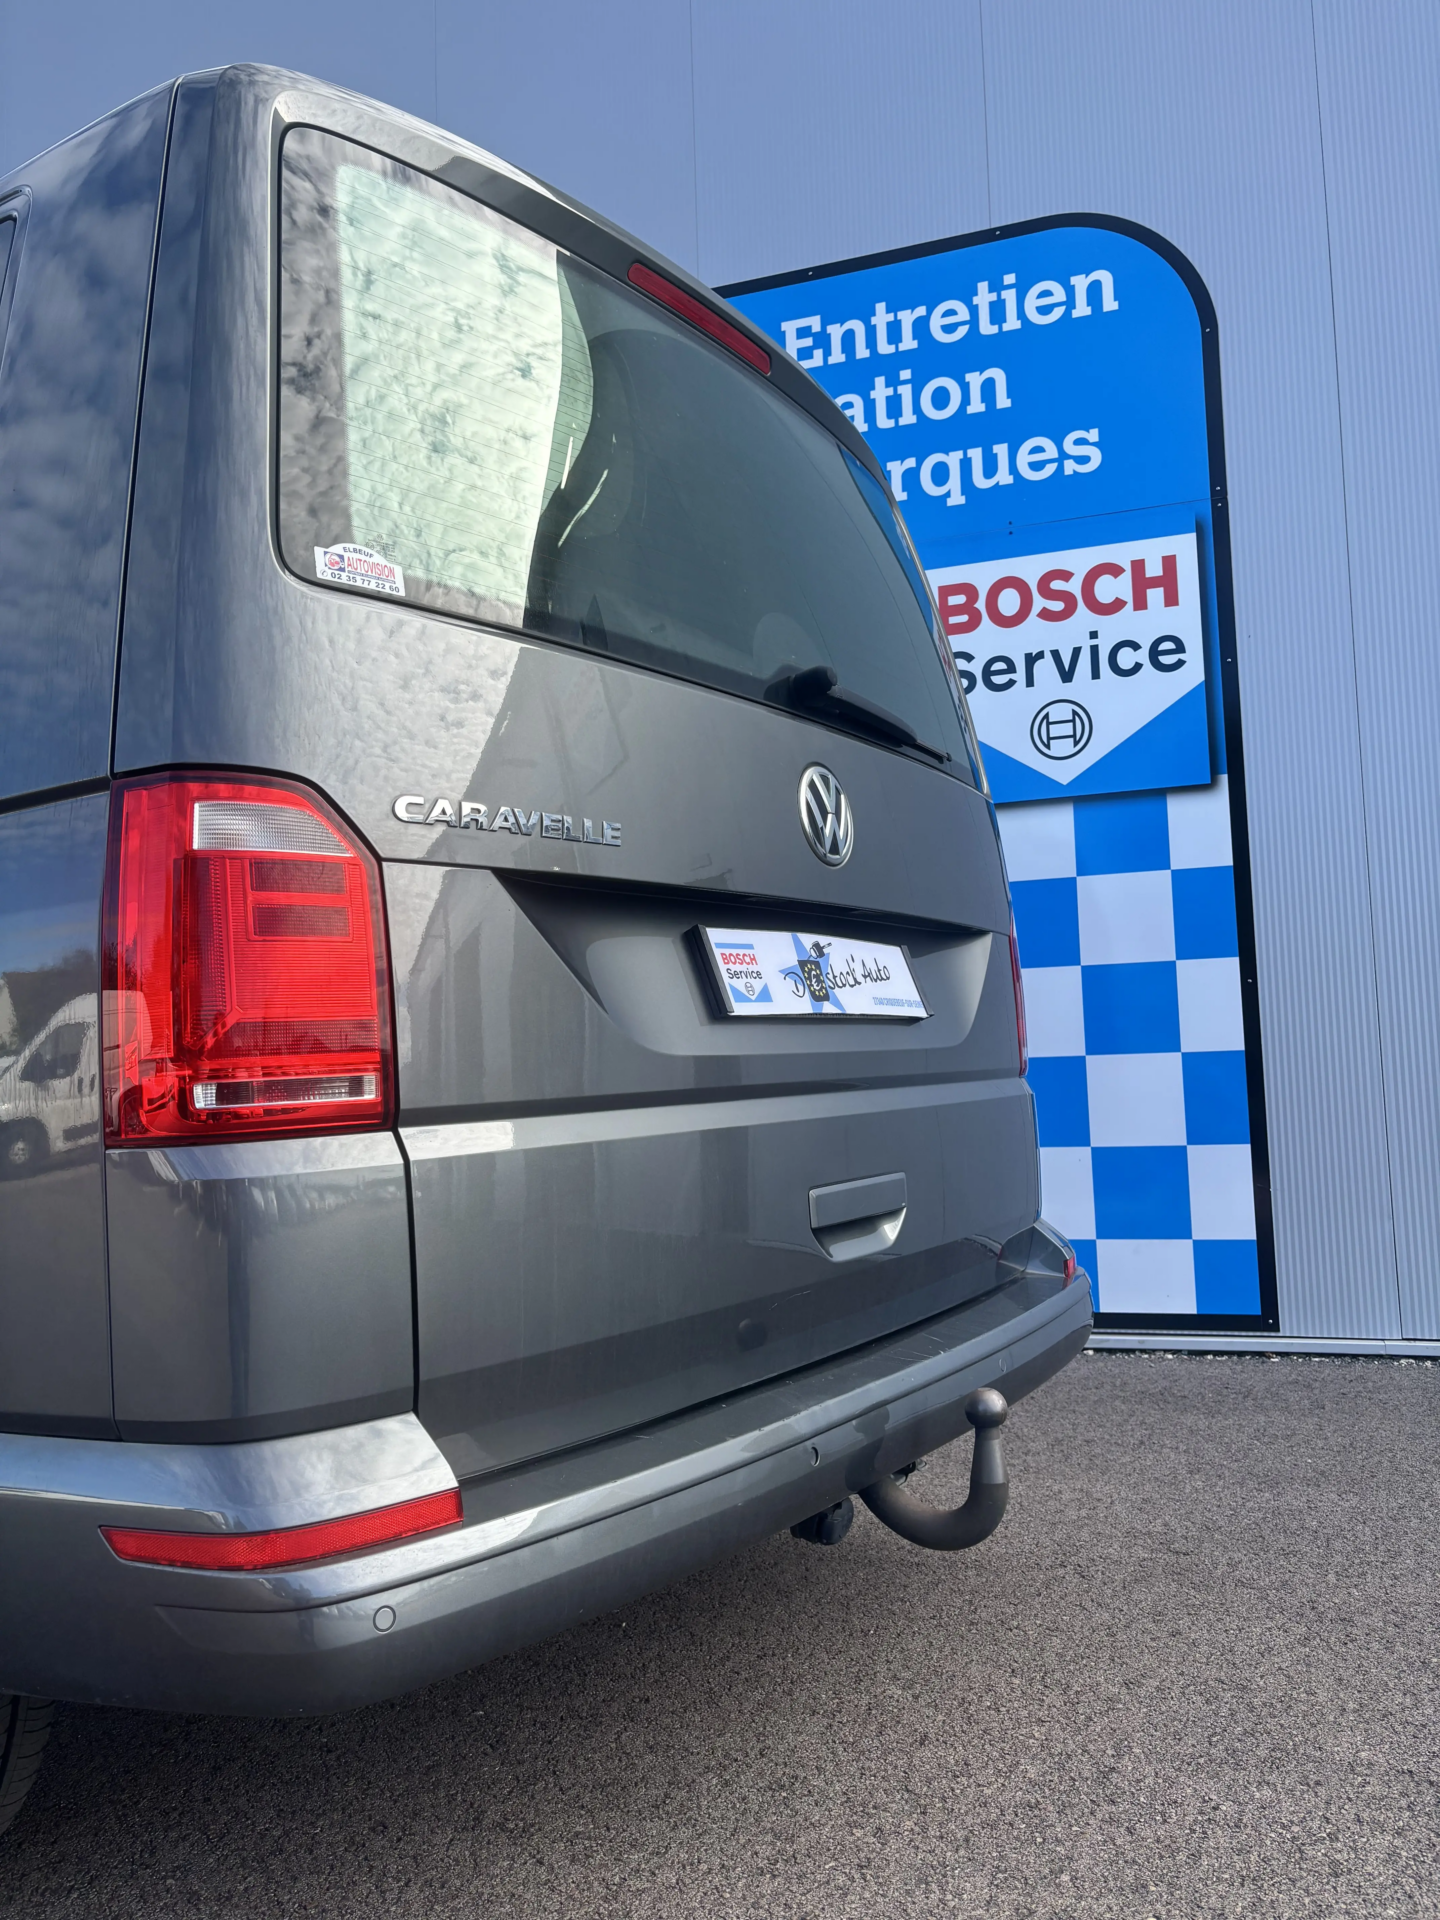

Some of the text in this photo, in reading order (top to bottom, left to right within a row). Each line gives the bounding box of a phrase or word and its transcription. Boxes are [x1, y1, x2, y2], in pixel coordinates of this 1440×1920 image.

[781, 268, 1119, 369] Entretien
[834, 365, 1012, 433] ation
[886, 428, 1102, 506] rques
[343, 547, 374, 558] ELBEUF
[347, 556, 395, 579] AUTOVISION
[331, 572, 342, 580] 02
[345, 574, 357, 584] 35
[360, 578, 372, 587] 77
[375, 581, 386, 590] 22
[389, 584, 400, 594] 60
[938, 554, 1180, 636] BOSCH
[953, 630, 1188, 696] Service
[393, 794, 622, 847] CARAVELLE
[720, 952, 758, 966] BOSCH
[726, 967, 763, 980] Service
[861, 957, 891, 984] Auto
